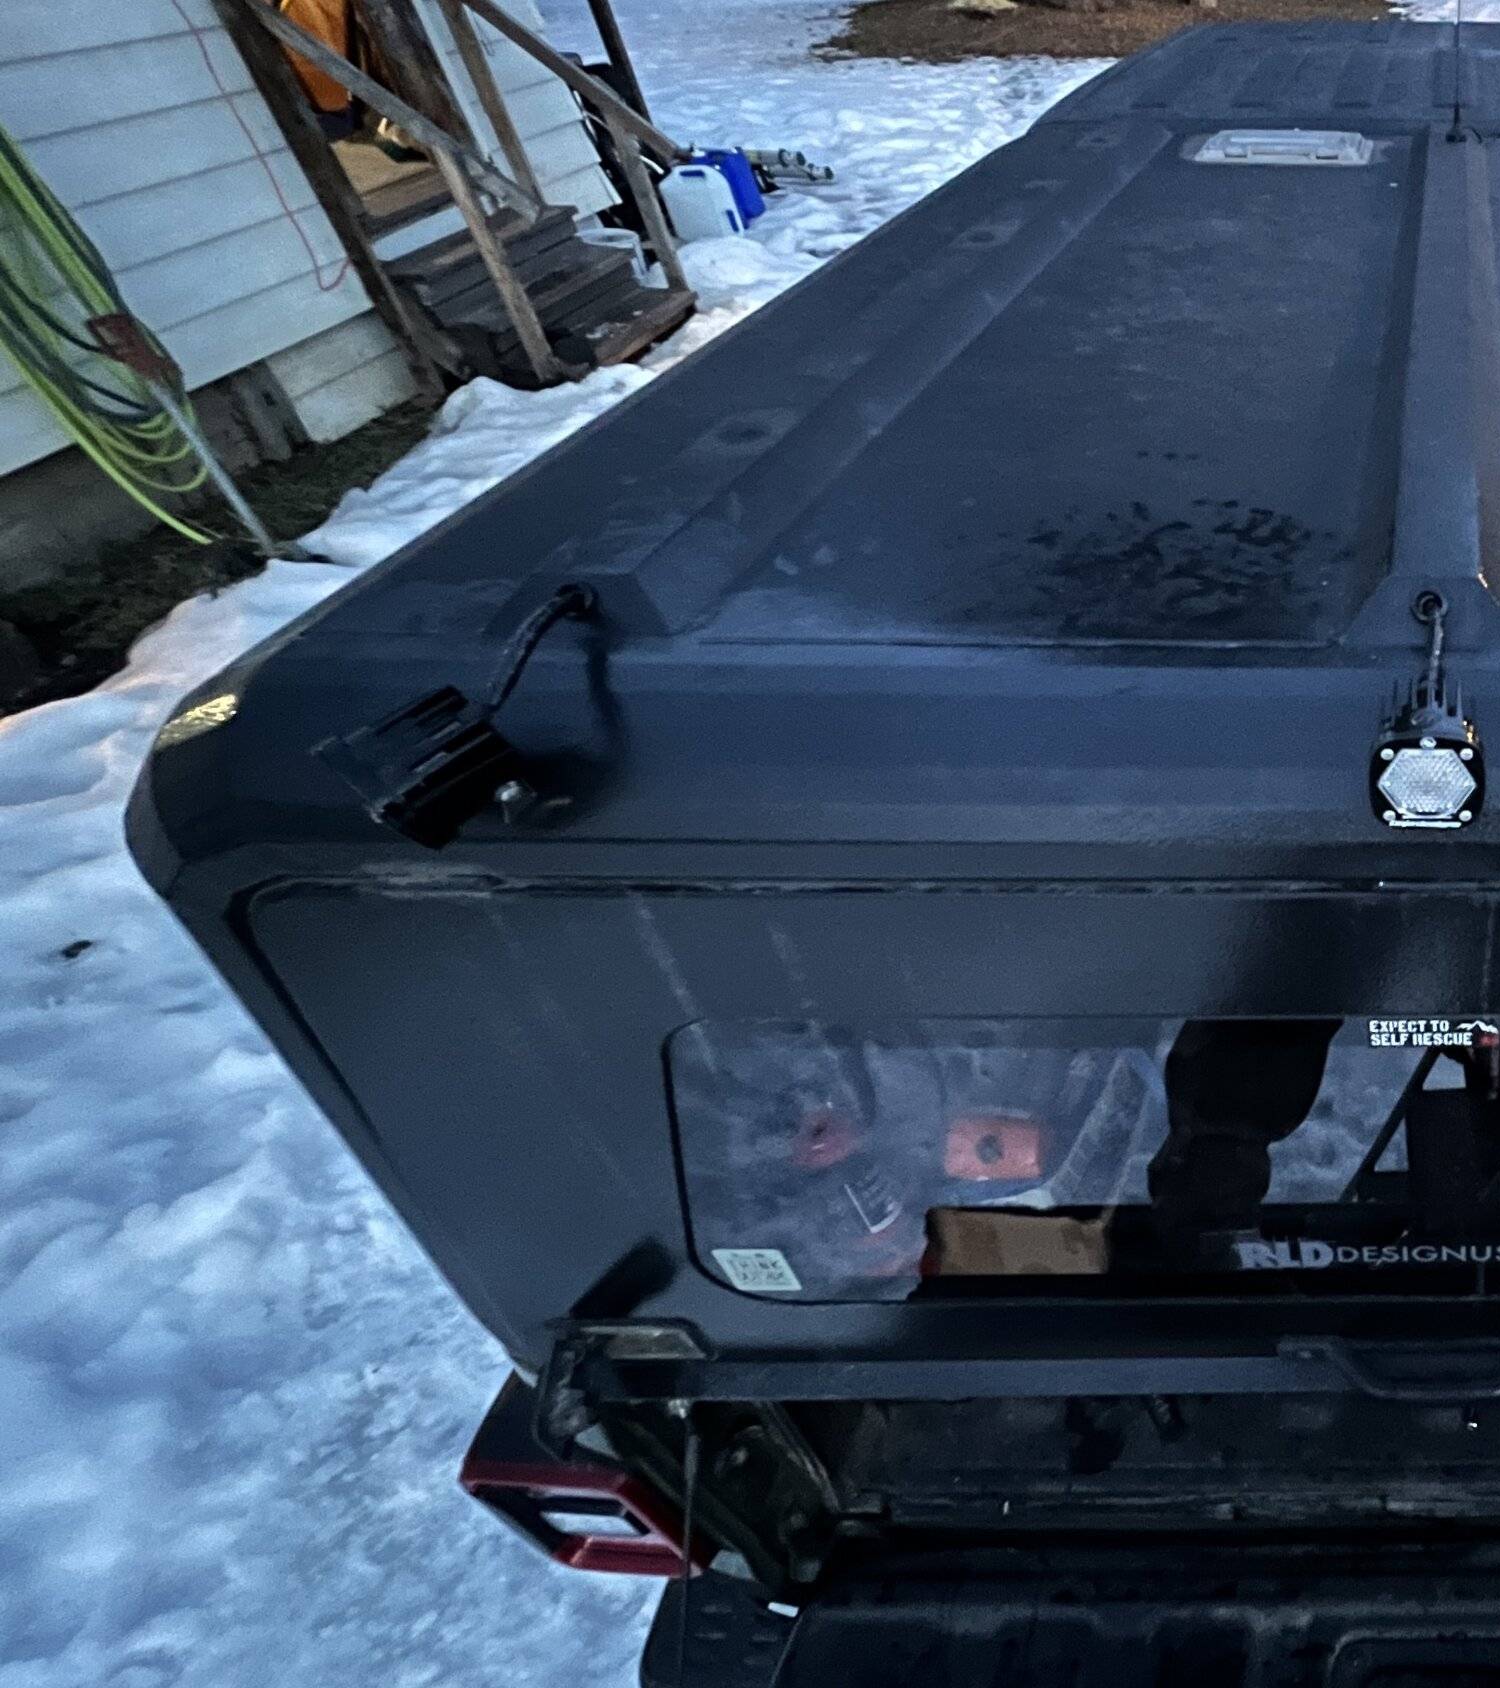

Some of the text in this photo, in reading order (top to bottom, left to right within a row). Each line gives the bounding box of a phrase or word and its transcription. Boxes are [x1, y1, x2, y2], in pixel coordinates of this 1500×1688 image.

[1369, 1019, 1450, 1033] EXPECT TO
[1370, 1032, 1473, 1046] SELF RESCUE
